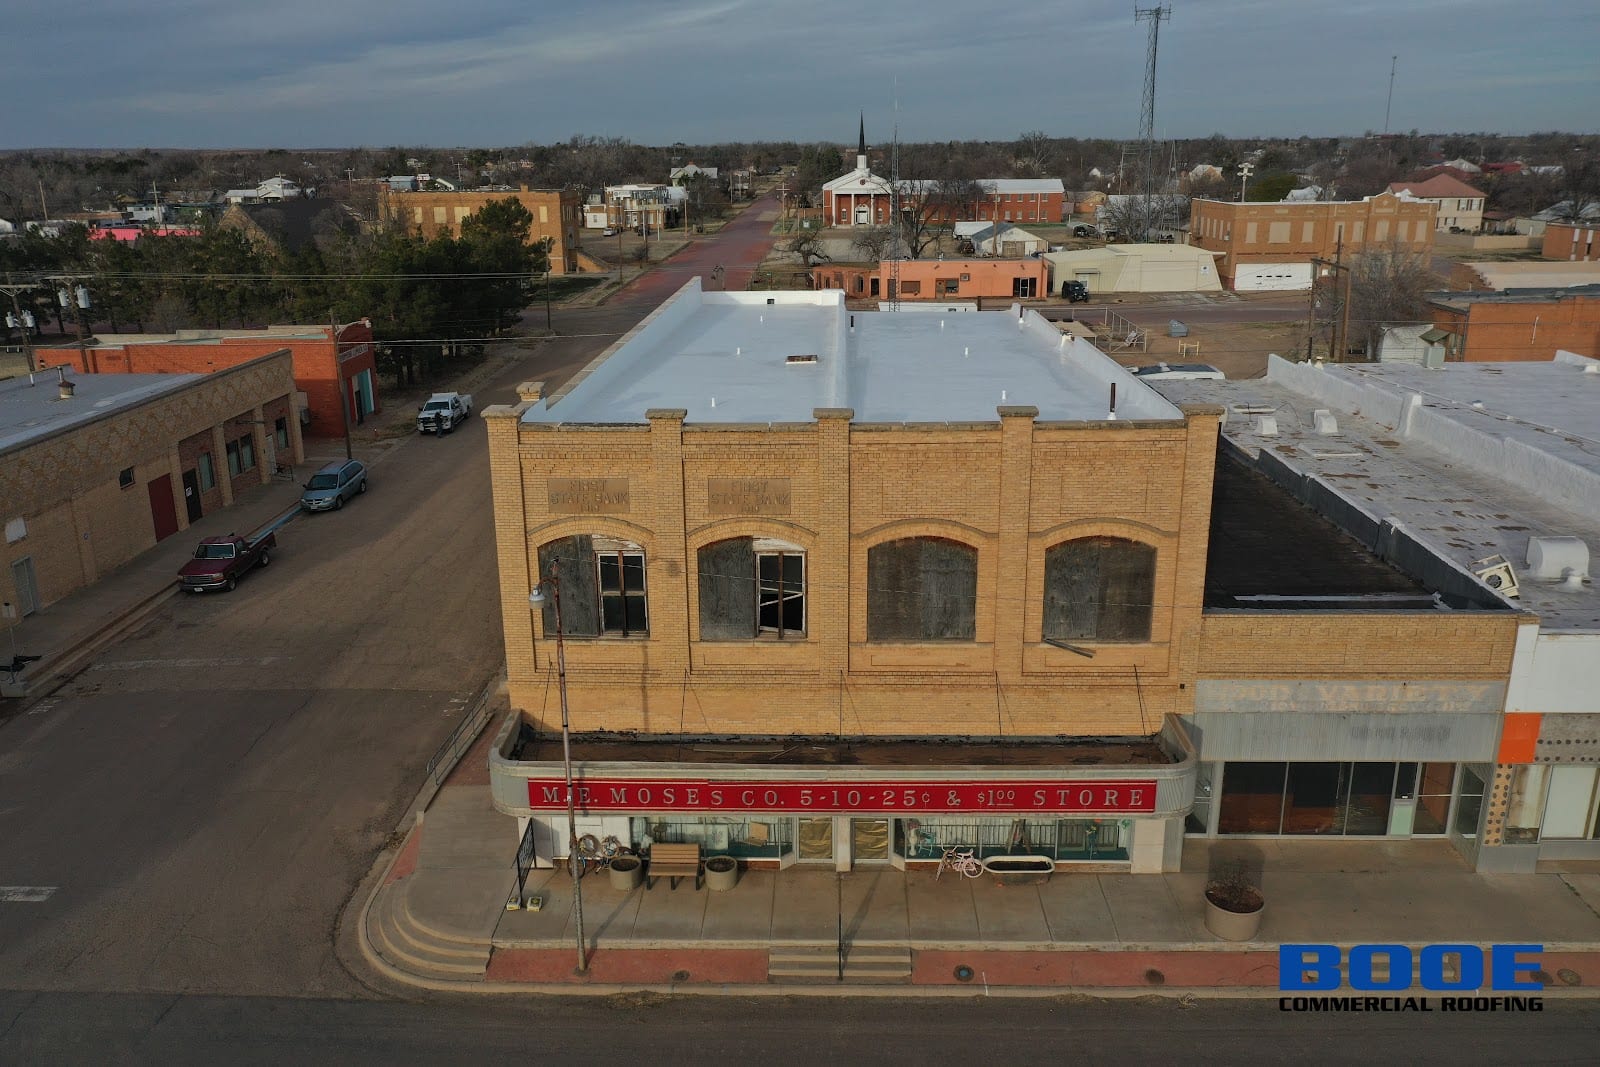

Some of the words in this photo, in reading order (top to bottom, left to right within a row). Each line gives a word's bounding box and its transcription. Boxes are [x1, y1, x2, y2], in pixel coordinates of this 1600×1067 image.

[551, 493, 590, 505] STATE
[595, 493, 629, 505] BANK
[711, 493, 751, 505] STATE
[756, 493, 789, 505] BANK
[542, 787, 598, 804] M.E.
[610, 788, 724, 805] MOSES
[741, 790, 785, 806] CO.
[946, 791, 961, 806] &
[1034, 789, 1143, 806] STORE
